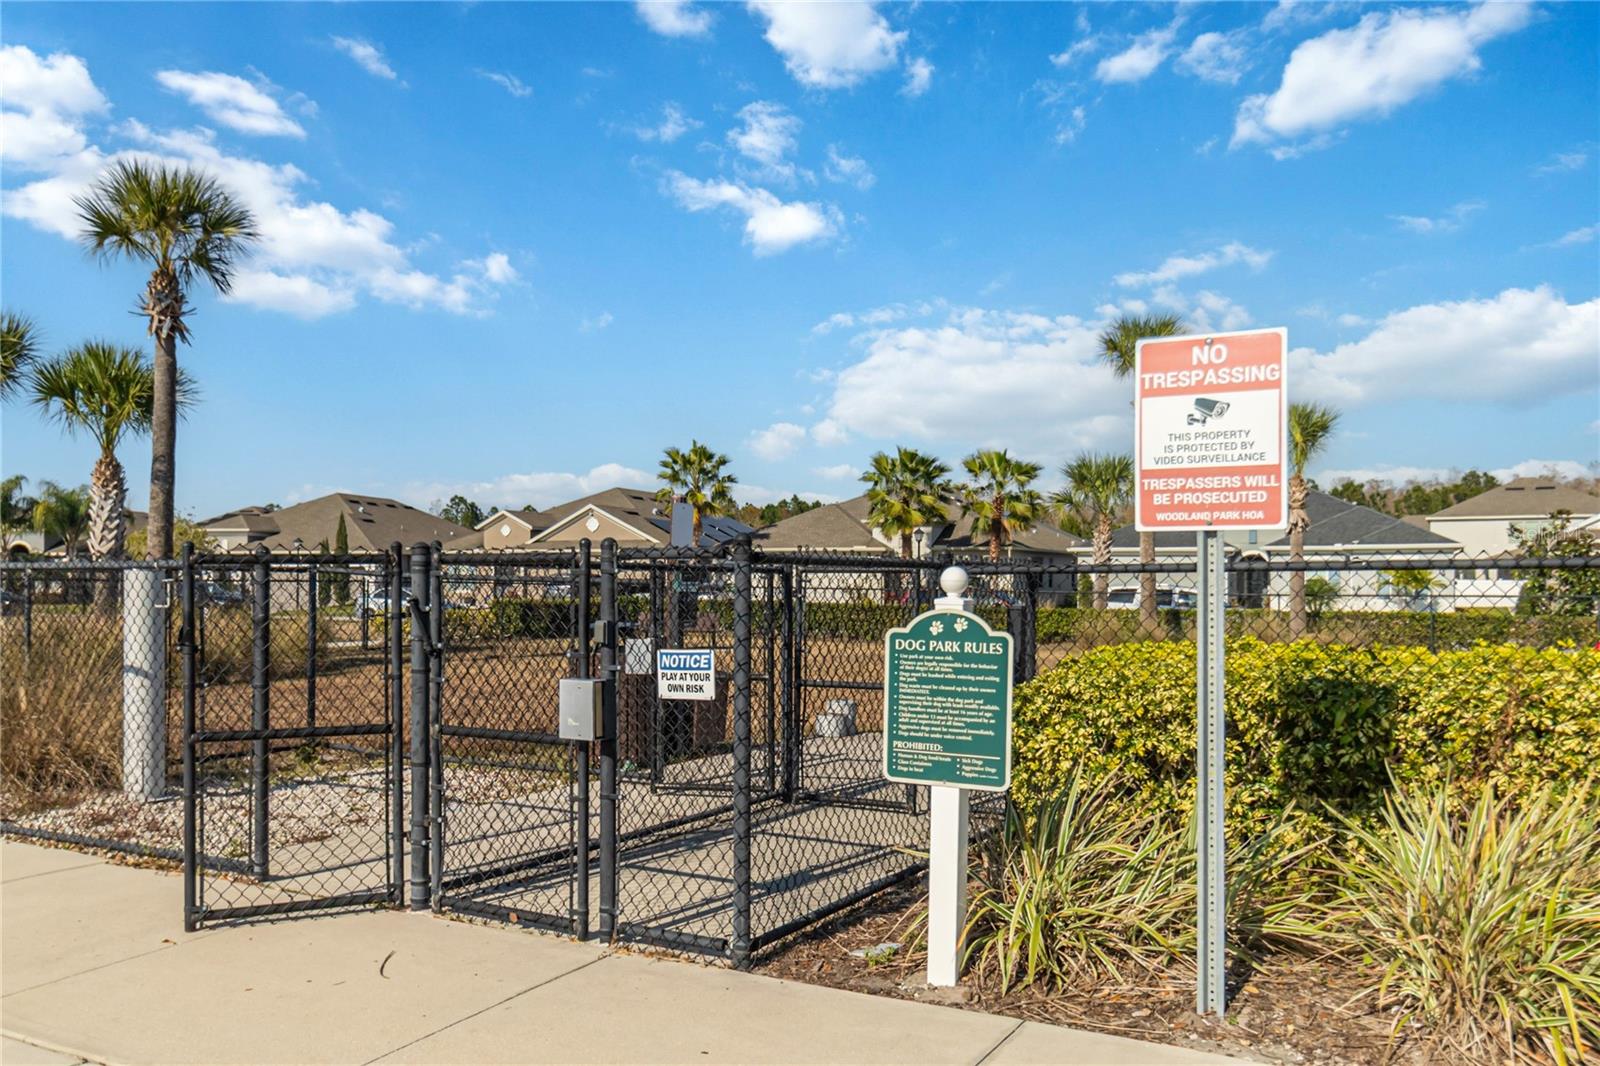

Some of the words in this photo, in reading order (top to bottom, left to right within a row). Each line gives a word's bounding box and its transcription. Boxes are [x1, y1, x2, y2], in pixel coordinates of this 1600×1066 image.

[1192, 344, 1227, 365] NO
[1142, 364, 1280, 389] TRESPASSING
[1168, 433, 1192, 442] THIS
[1194, 430, 1250, 440] PROPERTY
[1164, 445, 1174, 454] IS
[1176, 442, 1238, 453] PROTECTED
[1241, 441, 1254, 450] BY
[1154, 456, 1184, 465] VIDEO
[1187, 452, 1266, 464] SURVEILLANCE
[1142, 476, 1241, 490] TRESPASSERS
[1244, 475, 1279, 487] WILL
[1153, 494, 1171, 505] BE
[1174, 490, 1267, 504] PROSECUTED
[1156, 512, 1211, 521] WOODLAND
[1213, 511, 1240, 520] PARK
[1242, 510, 1264, 520] HOA
[895, 639, 926, 651] DOG
[930, 640, 960, 652] PARK
[964, 642, 1003, 654] RULES
[662, 654, 710, 668] NOTICE
[662, 672, 677, 680] PLAY
[679, 672, 688, 680] AT
[688, 672, 710, 682] YOUR
[668, 684, 684, 692] OWN
[686, 684, 704, 693] RISK
[893, 740, 943, 751] PROHIBITED:
